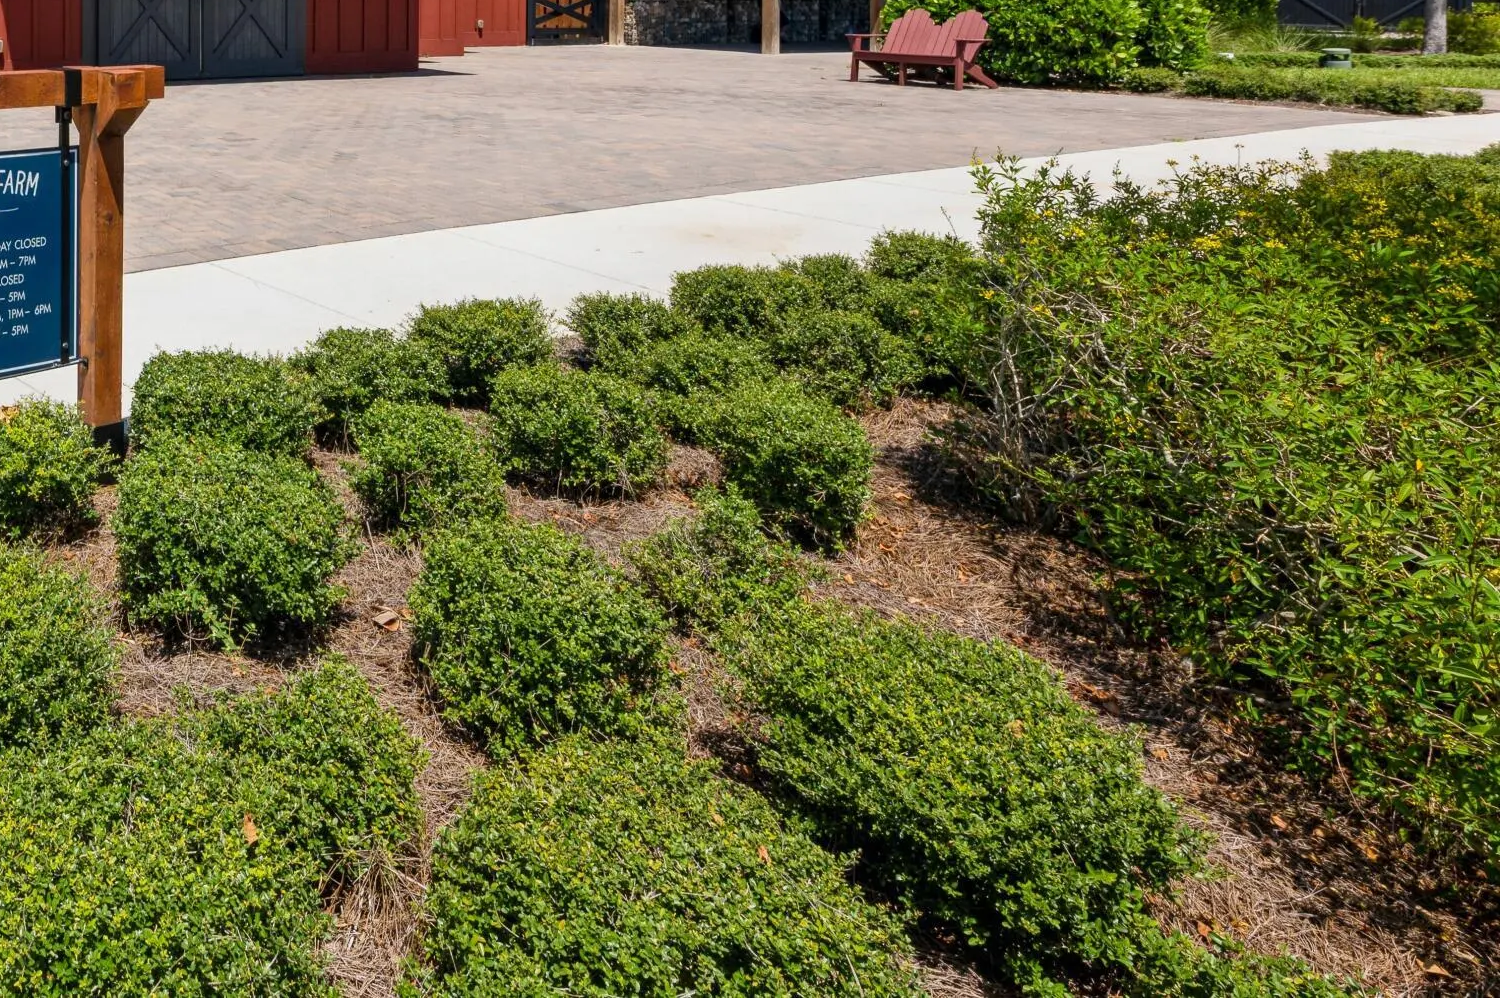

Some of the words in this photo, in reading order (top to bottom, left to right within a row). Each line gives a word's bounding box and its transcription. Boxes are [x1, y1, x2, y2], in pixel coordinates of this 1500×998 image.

[14, 236, 47, 250] CLOSED
[18, 255, 37, 267] 7PM
[7, 290, 26, 303] 5PM
[34, 303, 52, 316] 6PM
[11, 324, 29, 337] 5PM
